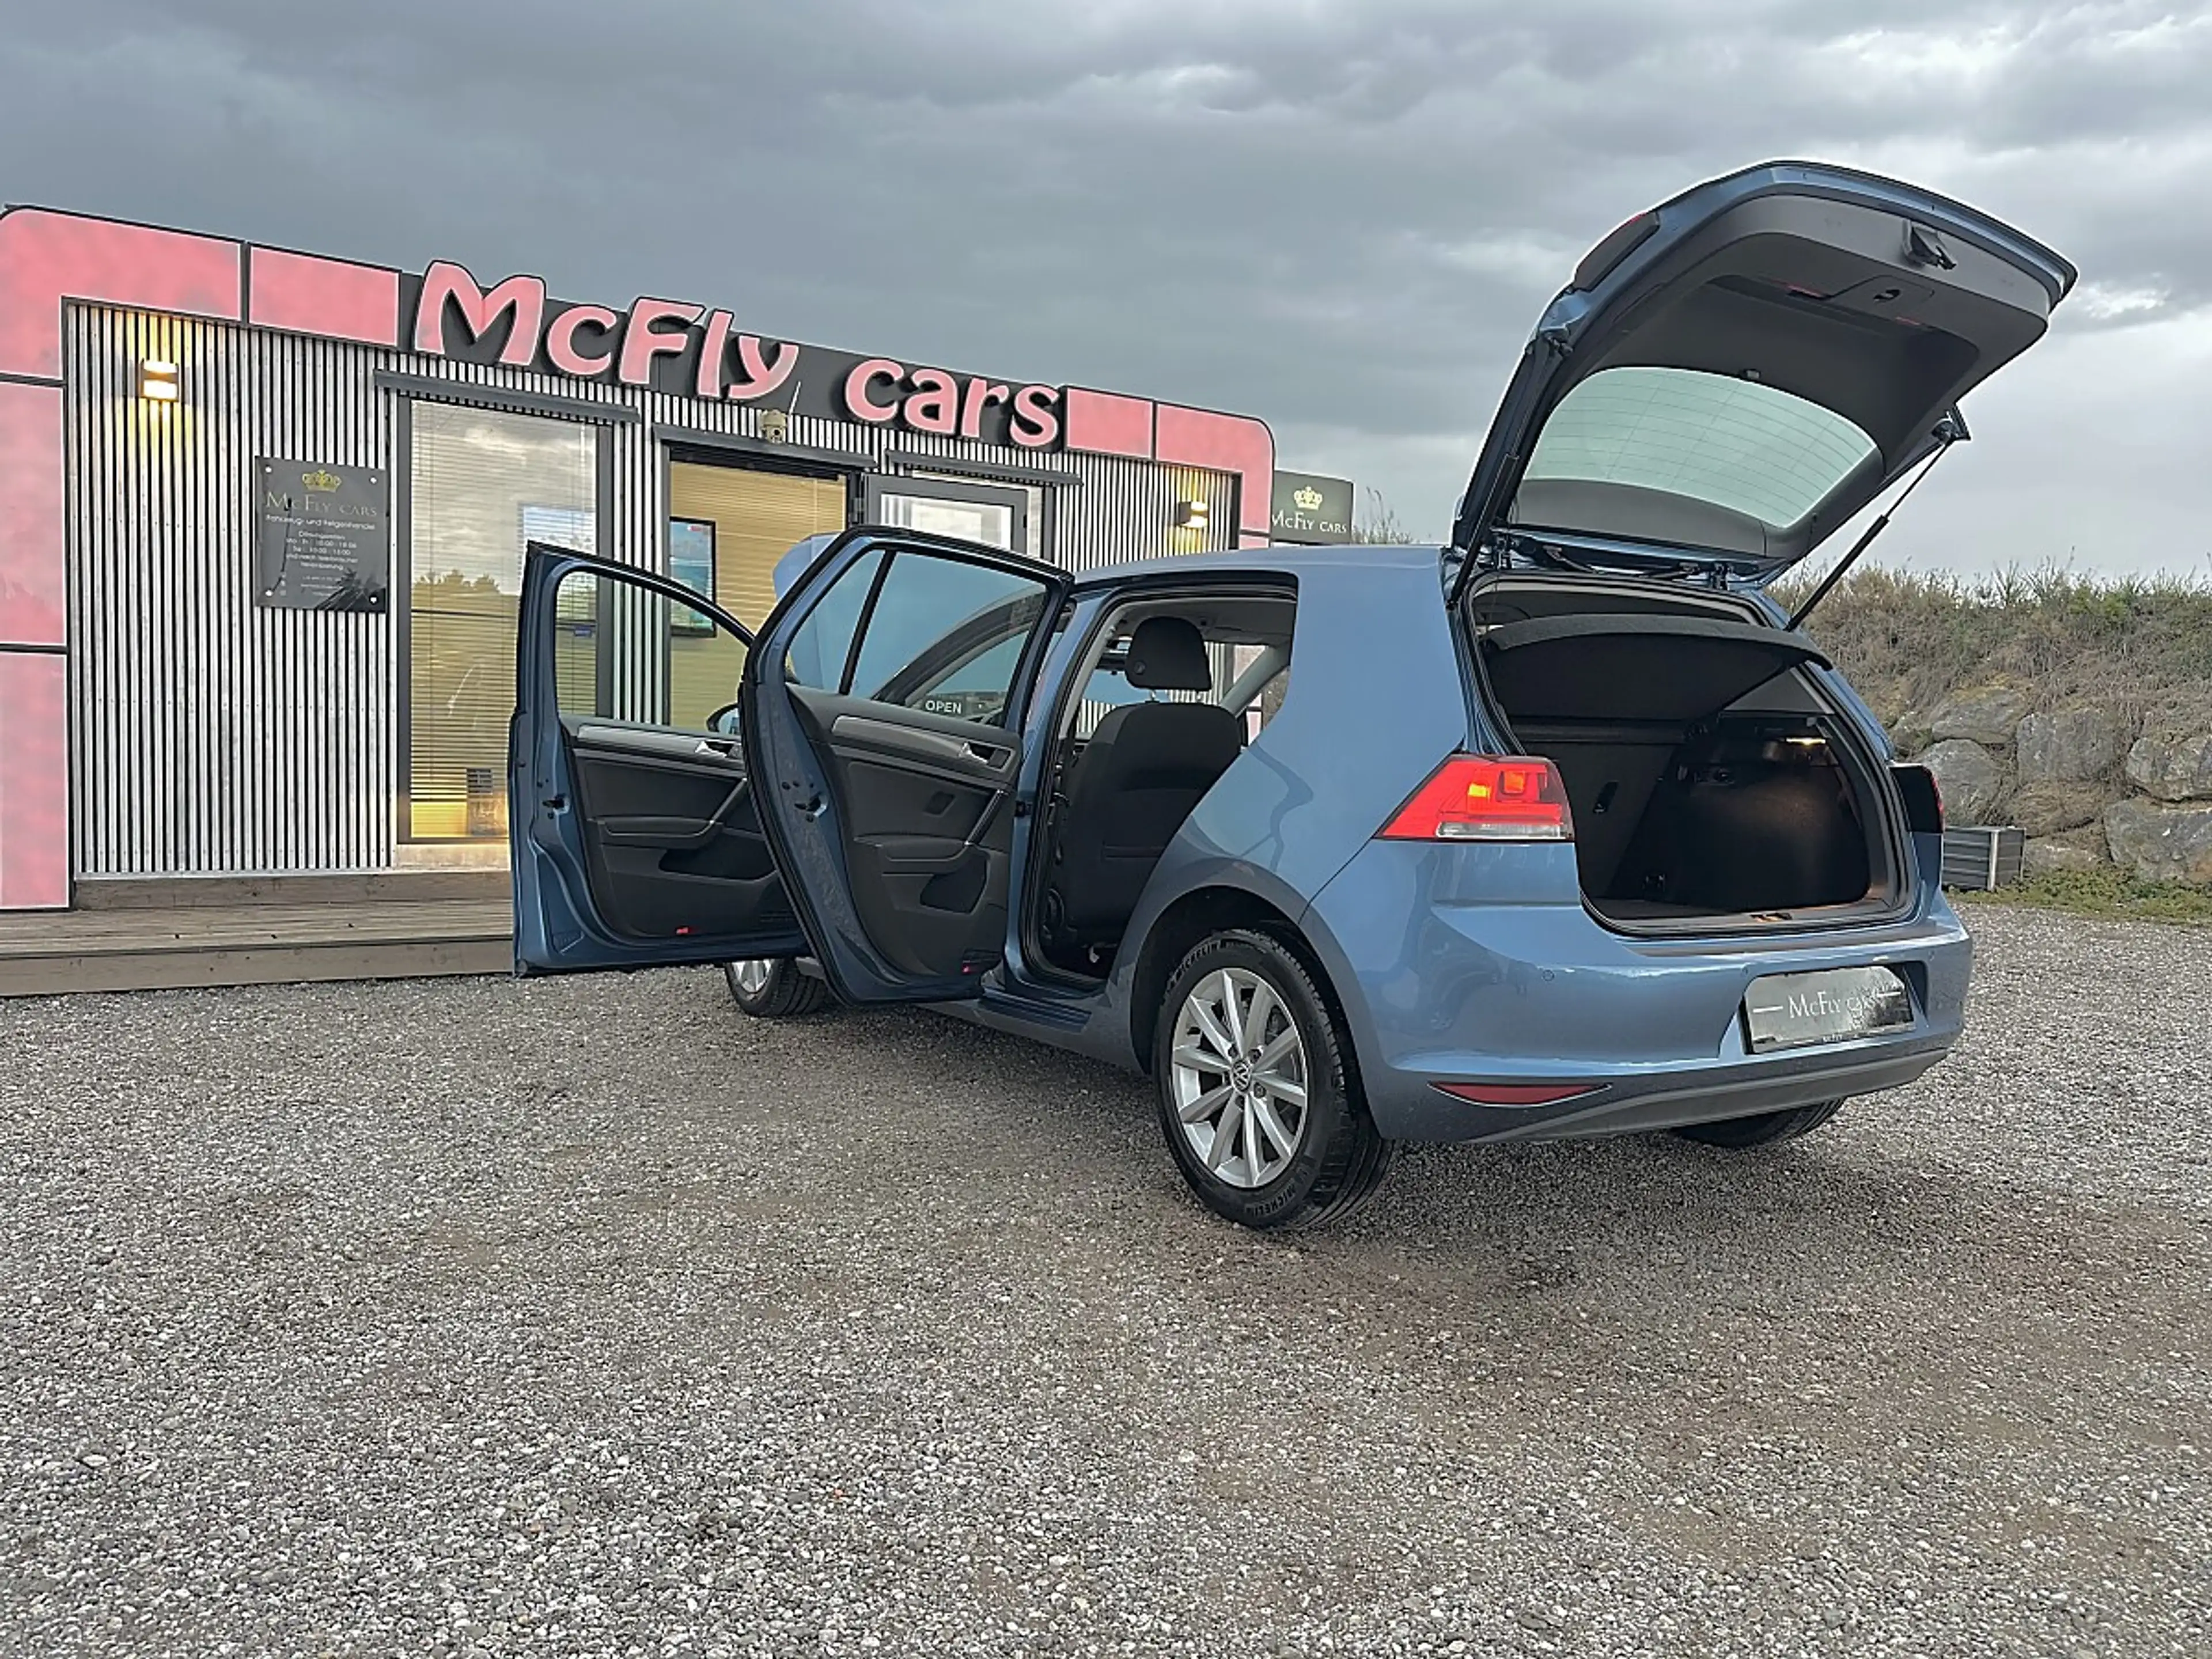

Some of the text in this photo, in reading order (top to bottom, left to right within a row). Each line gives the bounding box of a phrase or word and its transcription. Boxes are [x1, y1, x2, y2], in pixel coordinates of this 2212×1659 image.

[413, 259, 1059, 448] McFly cars
[339, 503, 377, 517] CARS
[1319, 521, 1347, 533] CARS
[925, 700, 962, 714] OPEN
